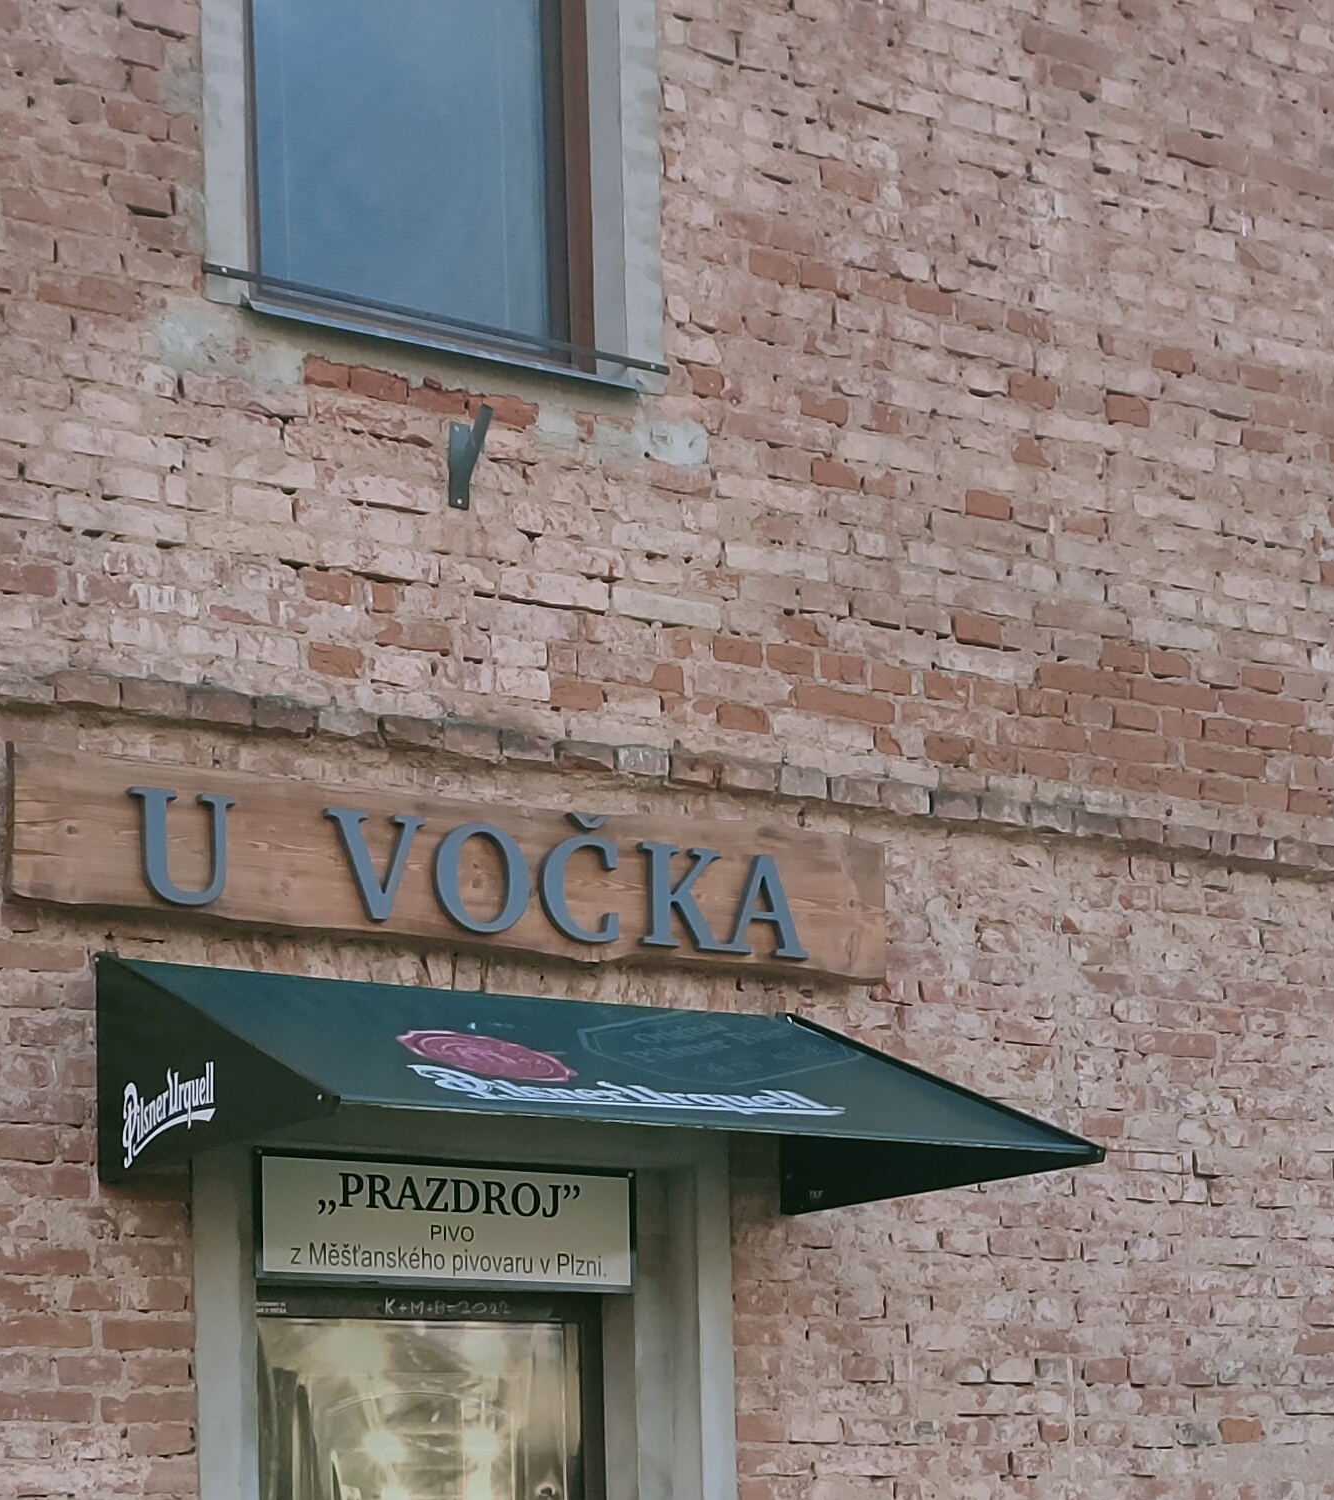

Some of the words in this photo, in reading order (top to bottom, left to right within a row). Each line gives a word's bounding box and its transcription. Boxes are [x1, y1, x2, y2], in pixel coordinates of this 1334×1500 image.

[127, 786, 237, 906] U
[322, 807, 809, 961] VOČKA
[406, 1064, 623, 1101] Pilsner
[596, 1080, 831, 1114] Urquell
[122, 1083, 169, 1169] Pilsner
[166, 1061, 214, 1129] Urquell
[430, 1224, 475, 1243] PIVO
[290, 1247, 302, 1266] z
[309, 1242, 446, 1271] Měšťanského
[451, 1249, 533, 1276] pivovaru
[539, 1256, 551, 1273] v
[556, 1253, 608, 1278] Plzni.
